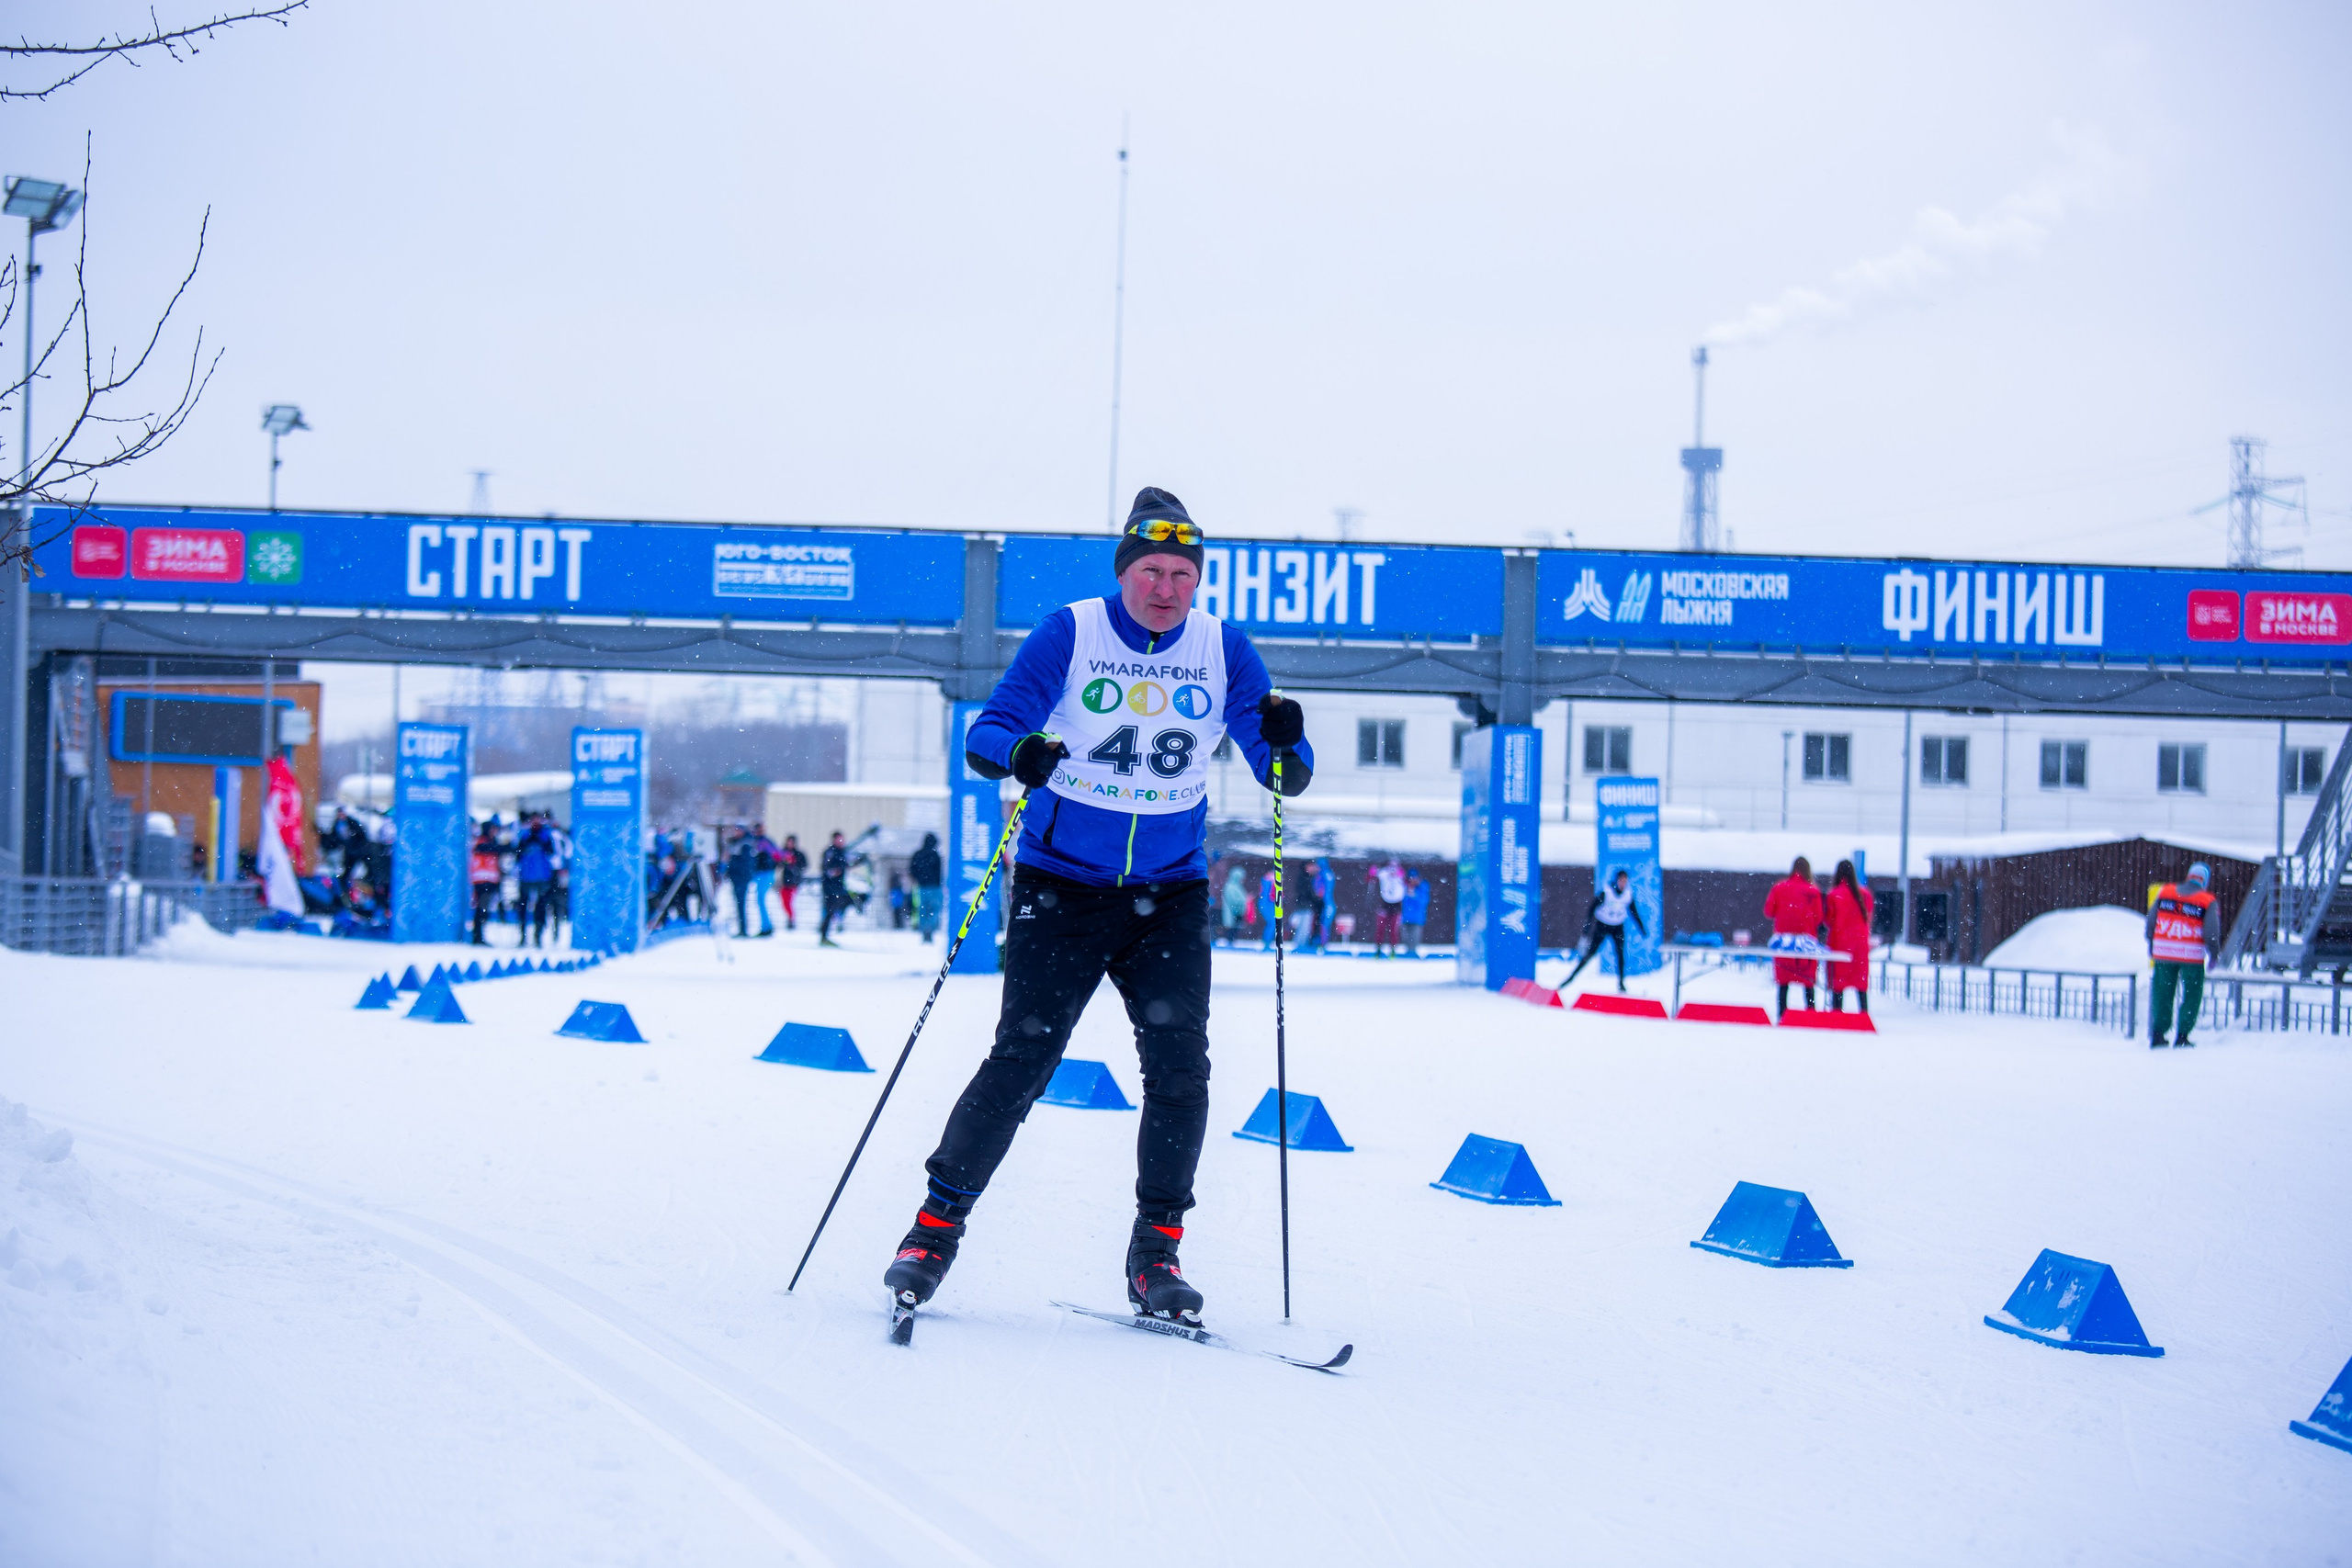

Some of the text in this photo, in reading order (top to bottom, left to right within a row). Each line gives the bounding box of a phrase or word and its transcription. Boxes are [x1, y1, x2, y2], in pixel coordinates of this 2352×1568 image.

[147, 536, 227, 559] ЗИМА
[714, 543, 853, 563] ЮГО-ВОСТОК
[407, 525, 593, 602] СТАРТ
[1197, 548, 1385, 626] АНЗИТ
[1661, 570, 1790, 601] МОСКОВСКАЯ
[1660, 598, 1733, 626] ЛЫЖНЯ
[1883, 568, 2105, 647] ФИНИШ
[2260, 599, 2338, 624] ЗИМА
[2259, 622, 2338, 637] В МОСКВЕ
[1090, 660, 1208, 682] VMARAFONE
[401, 728, 461, 759] СТАРТ
[575, 734, 637, 762] СТАРТ
[1088, 725, 1197, 780] 48
[1067, 775, 1206, 802] VMARAFONE.CLUB
[1134, 1319, 1191, 1339] MADSHUS
